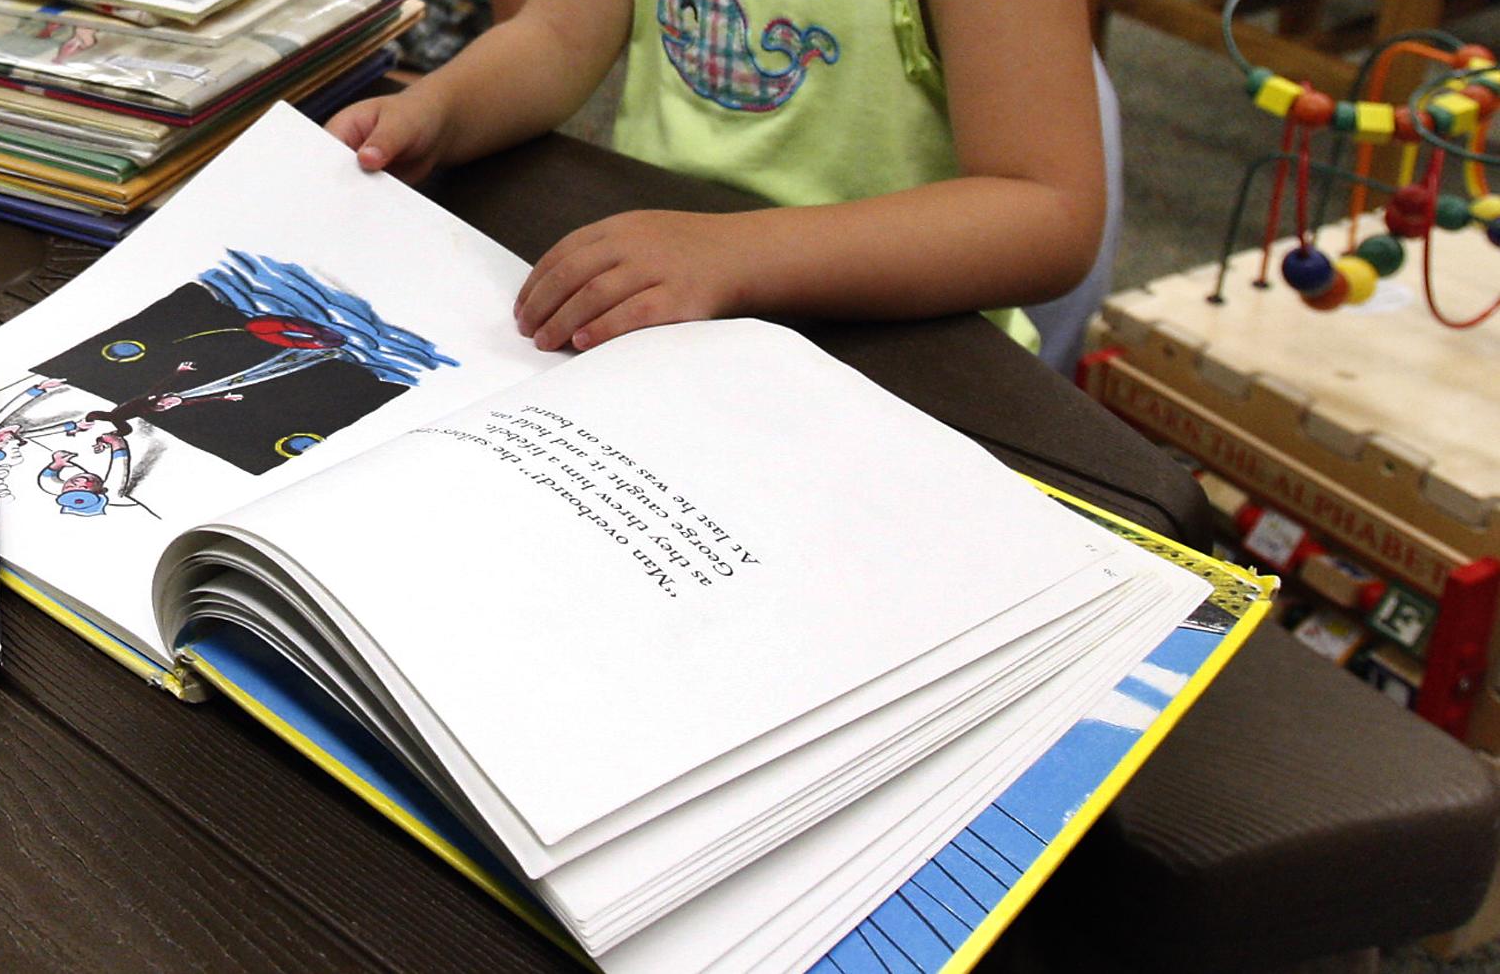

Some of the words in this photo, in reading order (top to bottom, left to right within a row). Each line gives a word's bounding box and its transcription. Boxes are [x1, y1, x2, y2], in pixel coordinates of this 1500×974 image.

[510, 417, 553, 437] held
[576, 428, 600, 443] on
[492, 445, 522, 463] the
[549, 437, 589, 458] and
[600, 444, 637, 467] safe
[548, 455, 560, 464] a
[588, 459, 607, 472] it
[560, 464, 597, 491] him
[636, 468, 669, 493] was
[607, 472, 669, 519] caught
[672, 495, 697, 514] he
[595, 491, 649, 532] threw
[696, 514, 732, 543] last
[648, 534, 691, 568] they
[671, 521, 734, 577] George
[729, 543, 763, 566] At
[690, 570, 713, 587] as
